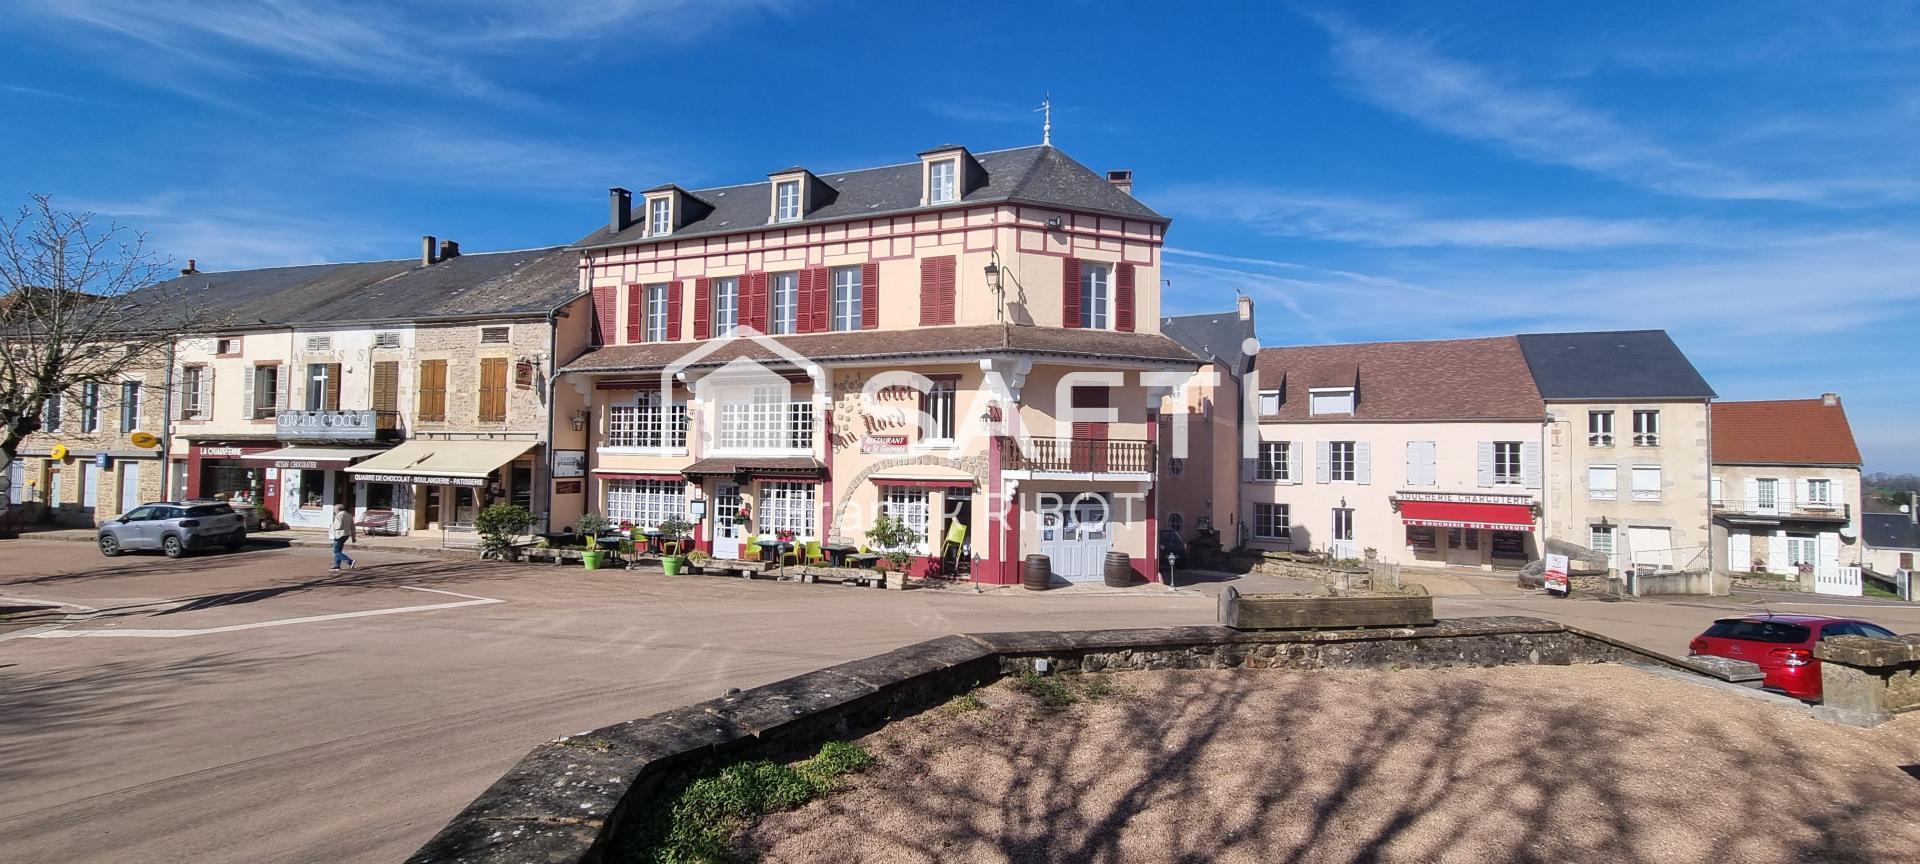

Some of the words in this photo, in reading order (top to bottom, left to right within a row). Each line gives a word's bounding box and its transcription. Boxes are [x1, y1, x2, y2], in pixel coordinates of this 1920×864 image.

[320, 414, 370, 427] CHOCOLAT
[861, 407, 906, 435] Nord
[865, 437, 905, 445] RESTAURANT
[200, 447, 207, 455] LA
[375, 474, 383, 482] DE
[383, 475, 410, 483] CHOCOLAT
[413, 476, 450, 485] BOULANGERIE
[453, 478, 484, 486] PATISSERIE
[1458, 495, 1530, 504] CHARCUTERIE
